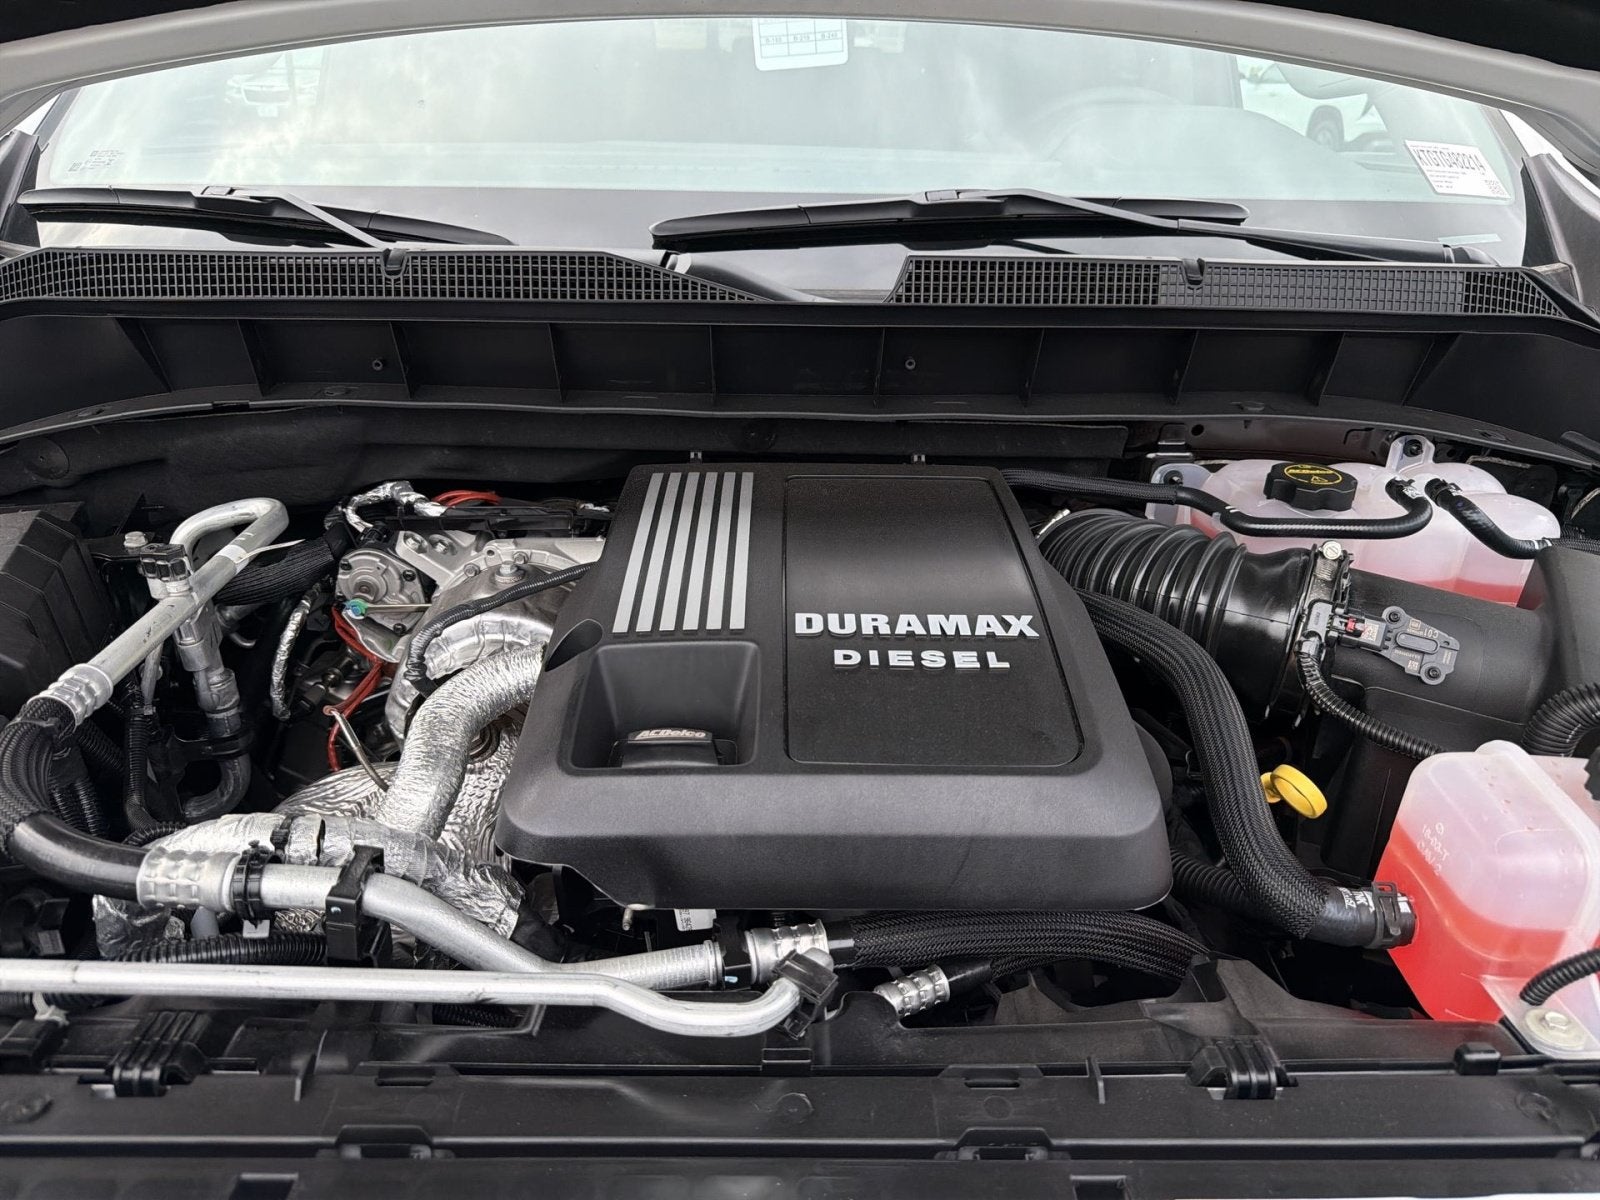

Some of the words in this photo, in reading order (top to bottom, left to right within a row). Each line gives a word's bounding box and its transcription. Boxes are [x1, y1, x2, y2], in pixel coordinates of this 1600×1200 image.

[795, 612, 1040, 638] DURAMAX
[834, 649, 1011, 670] DIESEL
[634, 729, 706, 740] ACDelco
